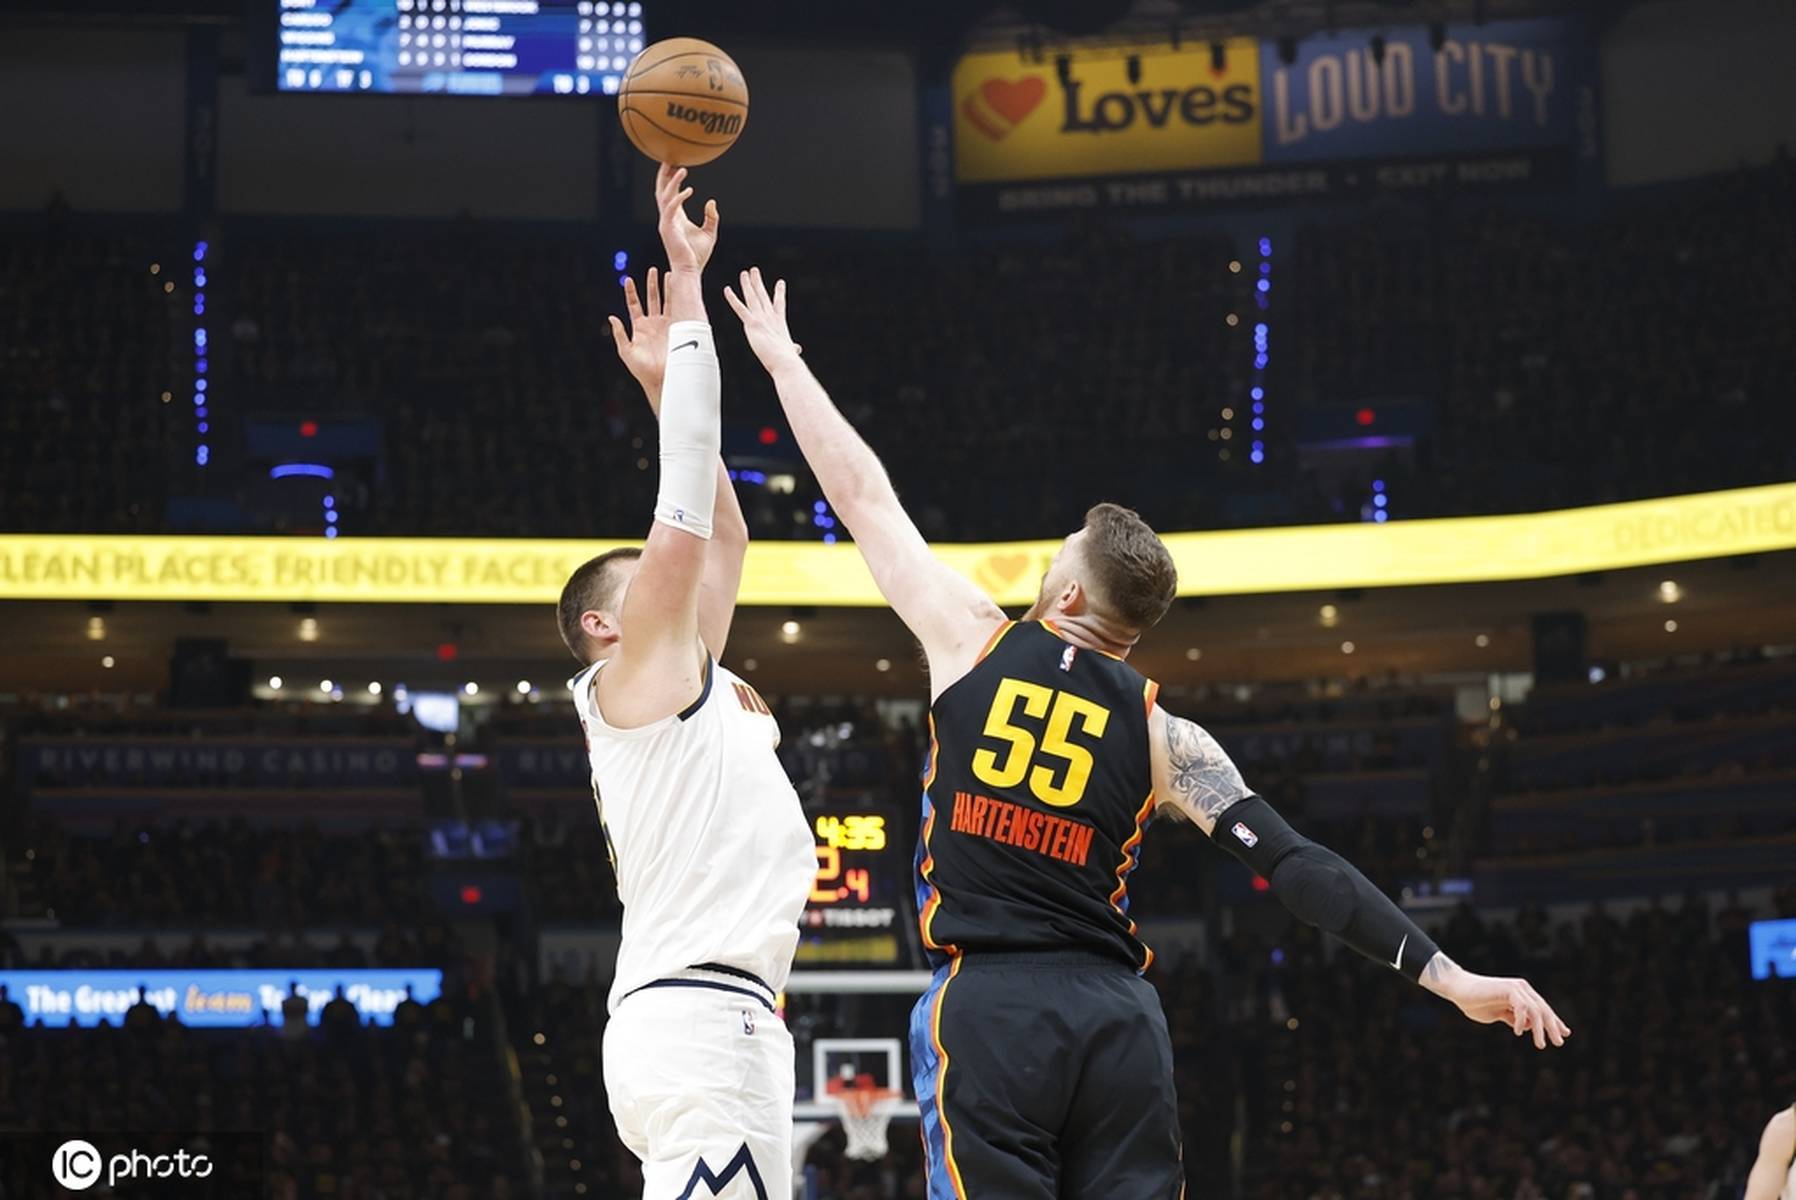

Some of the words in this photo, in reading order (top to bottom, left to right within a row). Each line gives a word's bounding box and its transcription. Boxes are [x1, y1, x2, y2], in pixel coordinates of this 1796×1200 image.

[1273, 41, 1414, 146] LOUD
[1434, 39, 1554, 126] CITY
[667, 101, 742, 135] Wilson
[1104, 180, 1169, 206] THE
[1177, 170, 1329, 200] THUNDER
[275, 553, 450, 586] FRIENDLY
[464, 553, 568, 586] FACES
[971, 677, 1111, 807] 55
[40, 747, 245, 774] RIVERWIND
[262, 747, 398, 774] CASINO
[816, 815, 886, 850] 4:35
[950, 791, 1095, 867] HARTENSTEIN
[823, 908, 895, 928] TISSOT
[26, 985, 72, 1014] The
